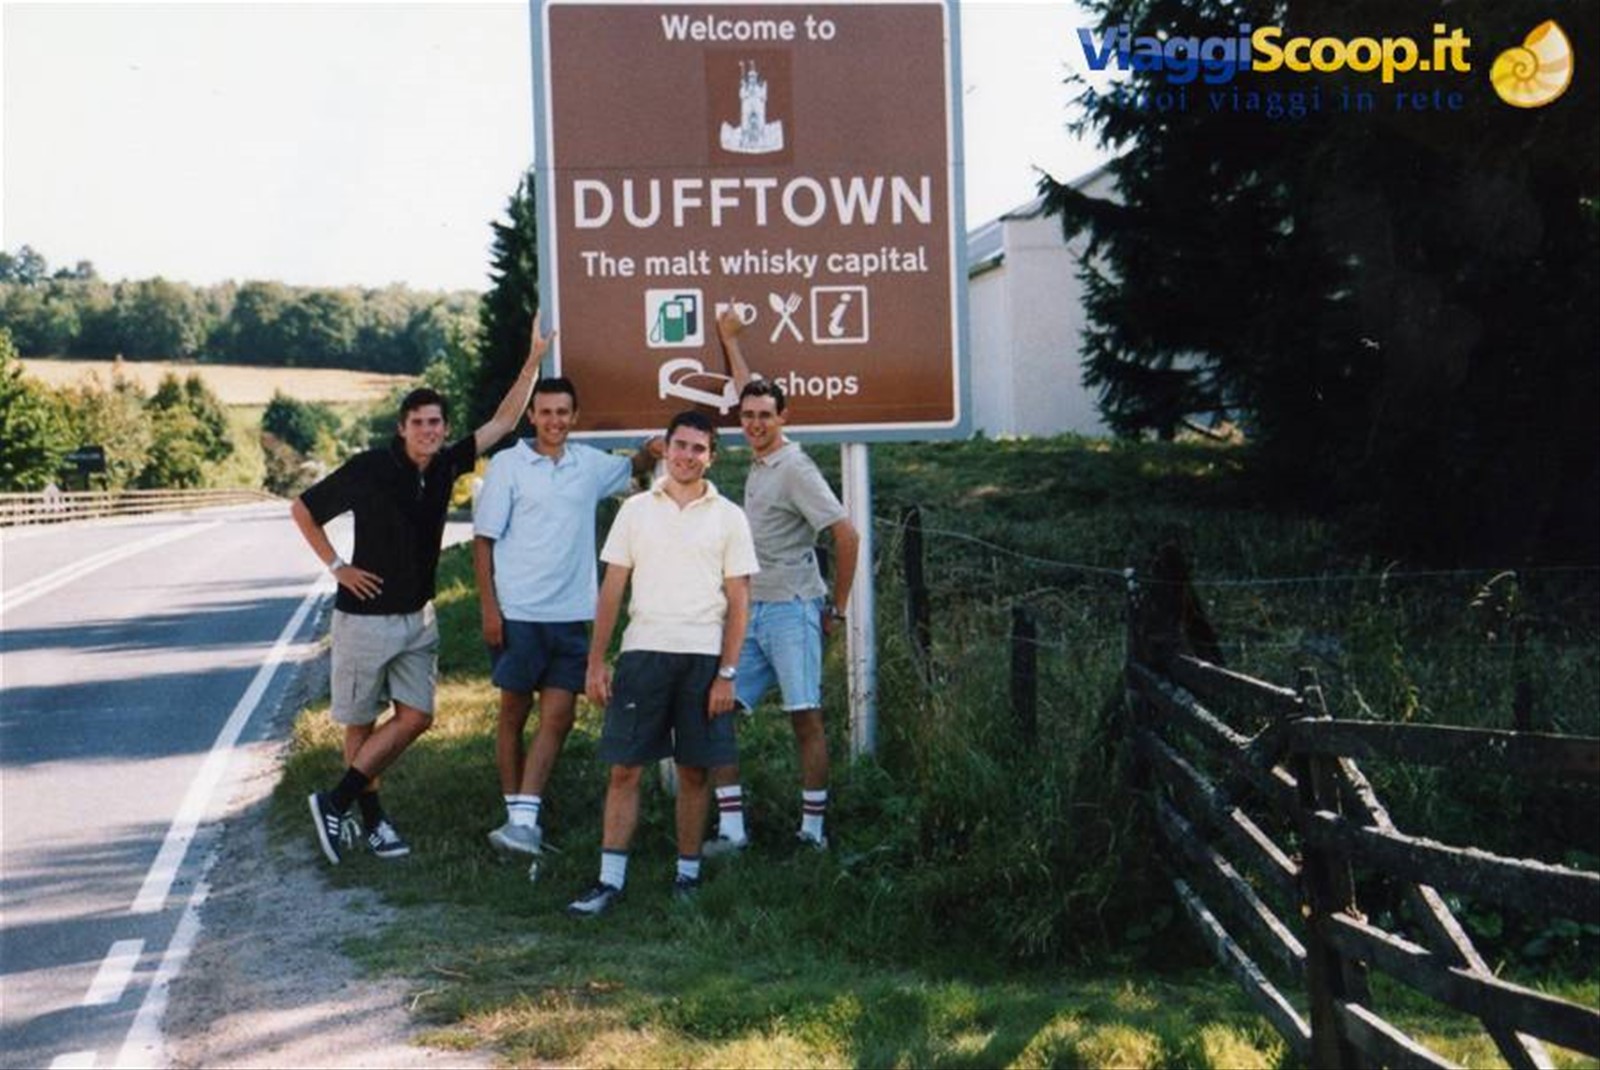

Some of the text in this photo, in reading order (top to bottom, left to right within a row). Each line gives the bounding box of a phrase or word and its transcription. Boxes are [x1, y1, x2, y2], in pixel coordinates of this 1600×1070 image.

[662, 14, 836, 41] Welcome to
[573, 177, 931, 228] DUFFTOWN
[580, 247, 928, 278] The malt whisky capital
[774, 371, 859, 400] shops
